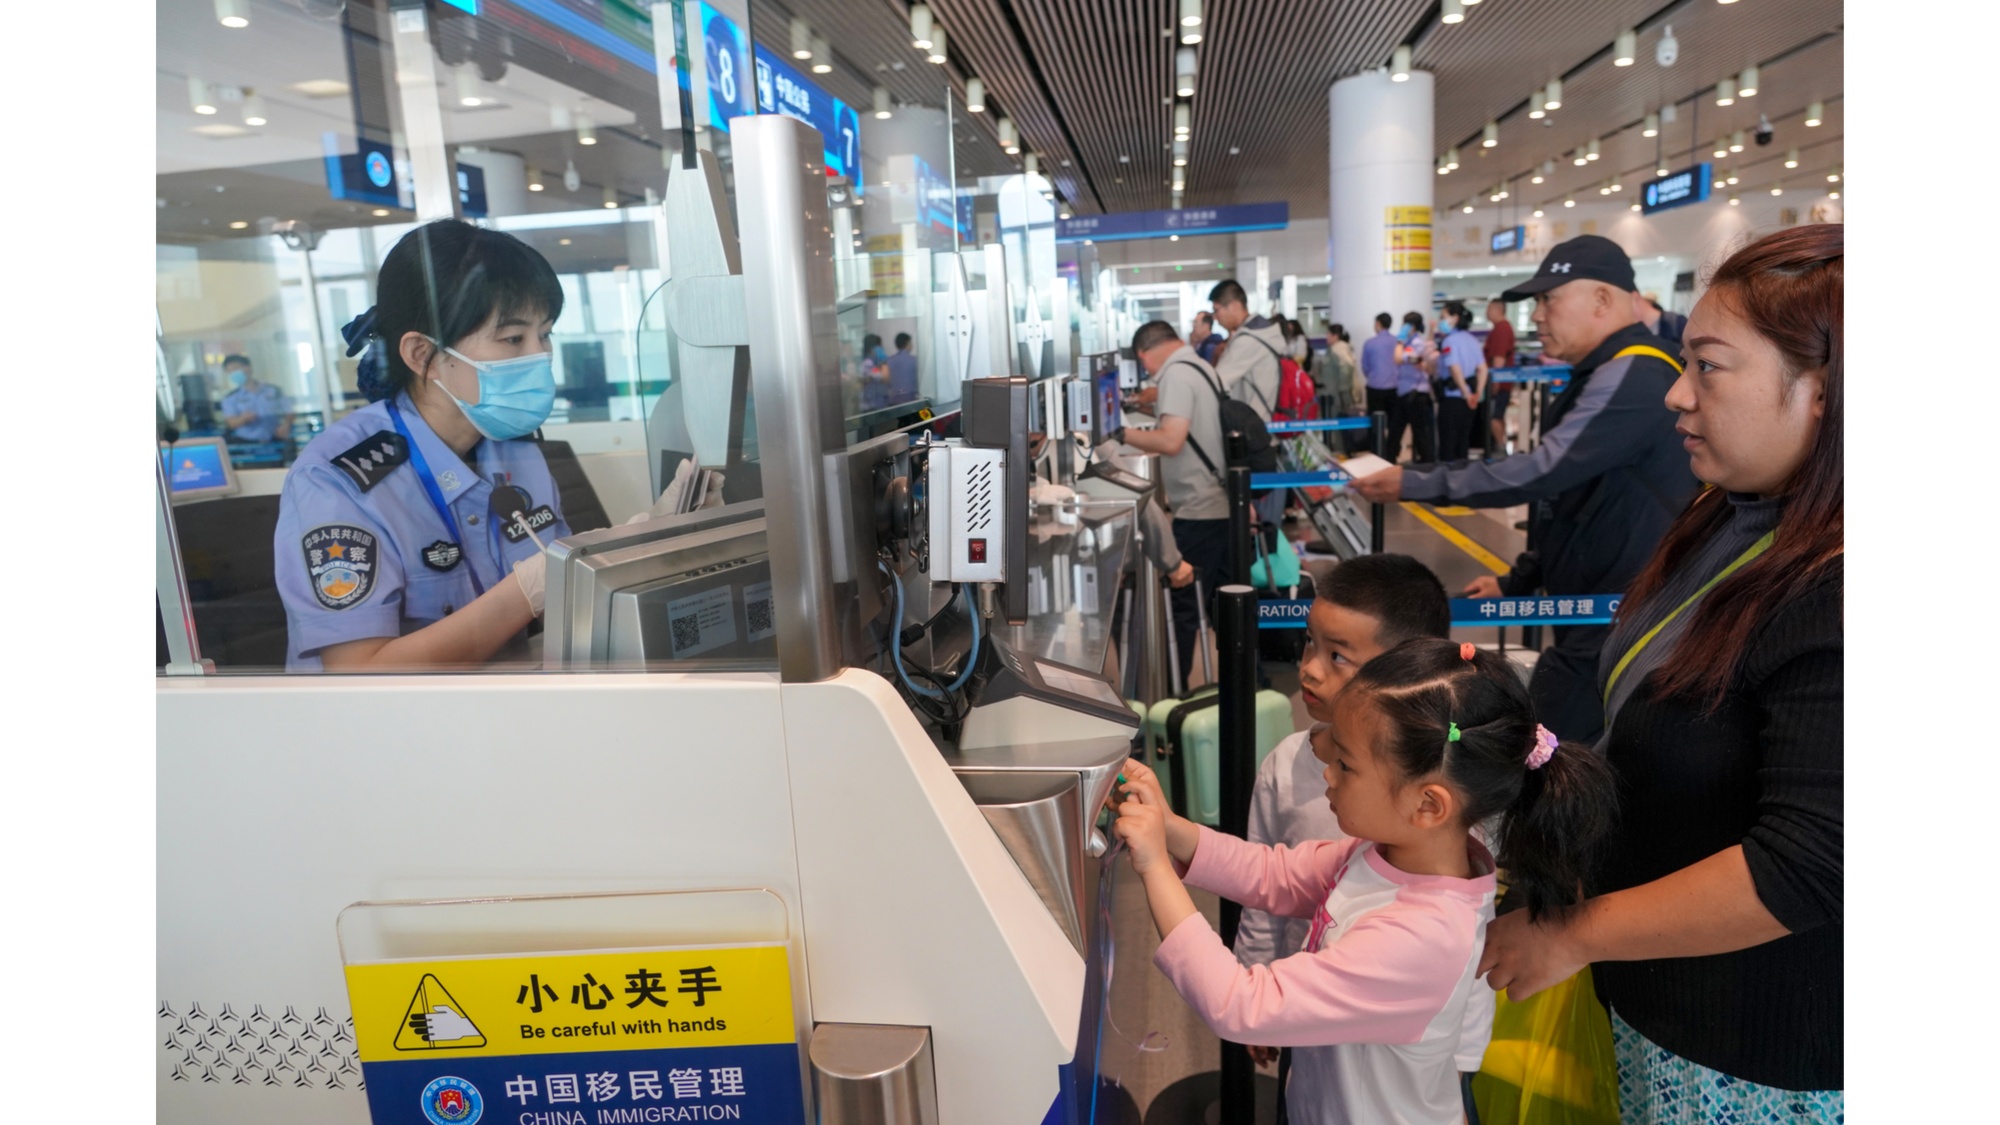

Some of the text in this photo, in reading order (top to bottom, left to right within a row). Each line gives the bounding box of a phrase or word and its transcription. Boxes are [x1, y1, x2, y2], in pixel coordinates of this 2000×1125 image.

[719, 47, 736, 104] 8
[843, 127, 854, 168] 7
[304, 528, 373, 549] 中华人民共和国
[1258, 604, 1312, 618] RATION
[1480, 599, 1594, 618] 中国移民管理
[516, 966, 722, 1013] 小心夹手
[520, 1016, 727, 1039] Be careful with hands
[505, 1066, 746, 1106] 中国移民管理
[519, 1104, 741, 1125] CHINA IMMIGRATION
